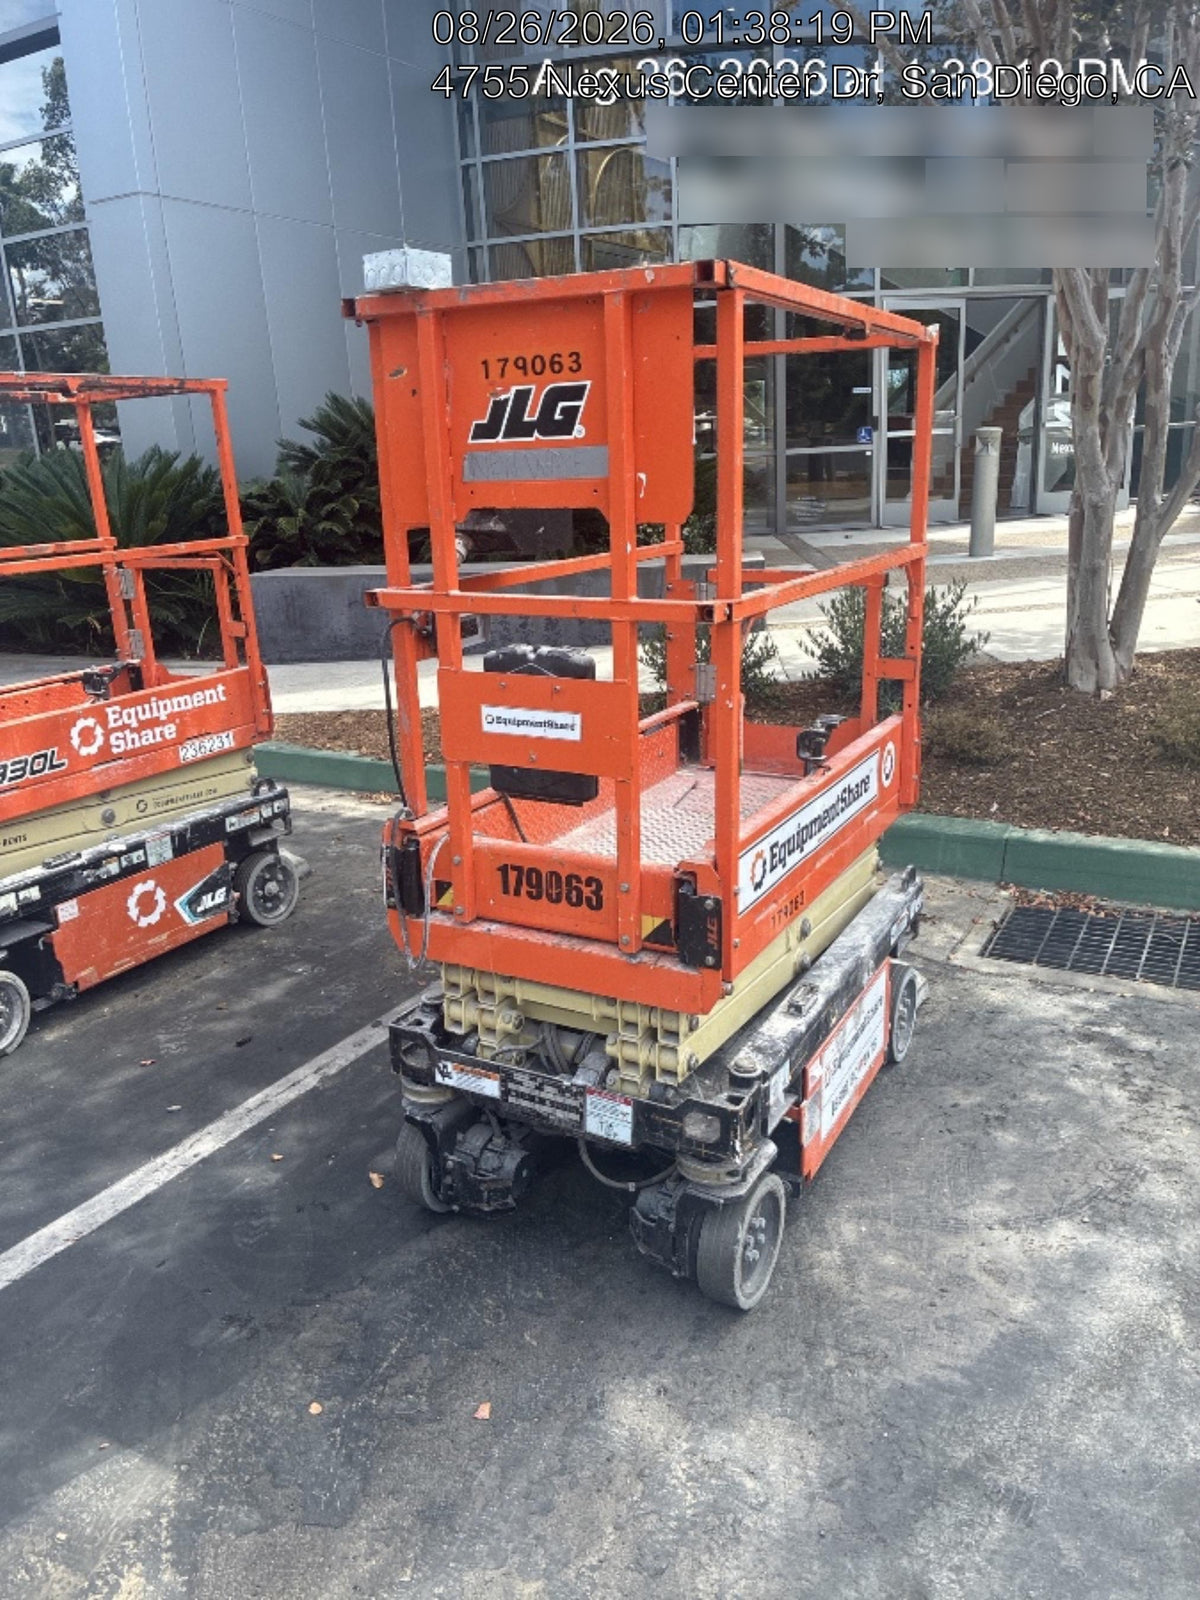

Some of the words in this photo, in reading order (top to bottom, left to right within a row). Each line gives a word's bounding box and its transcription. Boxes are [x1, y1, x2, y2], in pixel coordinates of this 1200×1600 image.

[481, 351, 583, 380] 179063
[467, 380, 593, 444] JLG
[1051, 442, 1075, 455] Nexu
[105, 683, 227, 731] Equipment
[109, 724, 178, 755] Share
[180, 731, 233, 763] 236231
[769, 773, 871, 874] EquipmentShare
[196, 886, 227, 913] JLG
[496, 863, 605, 912] 179063
